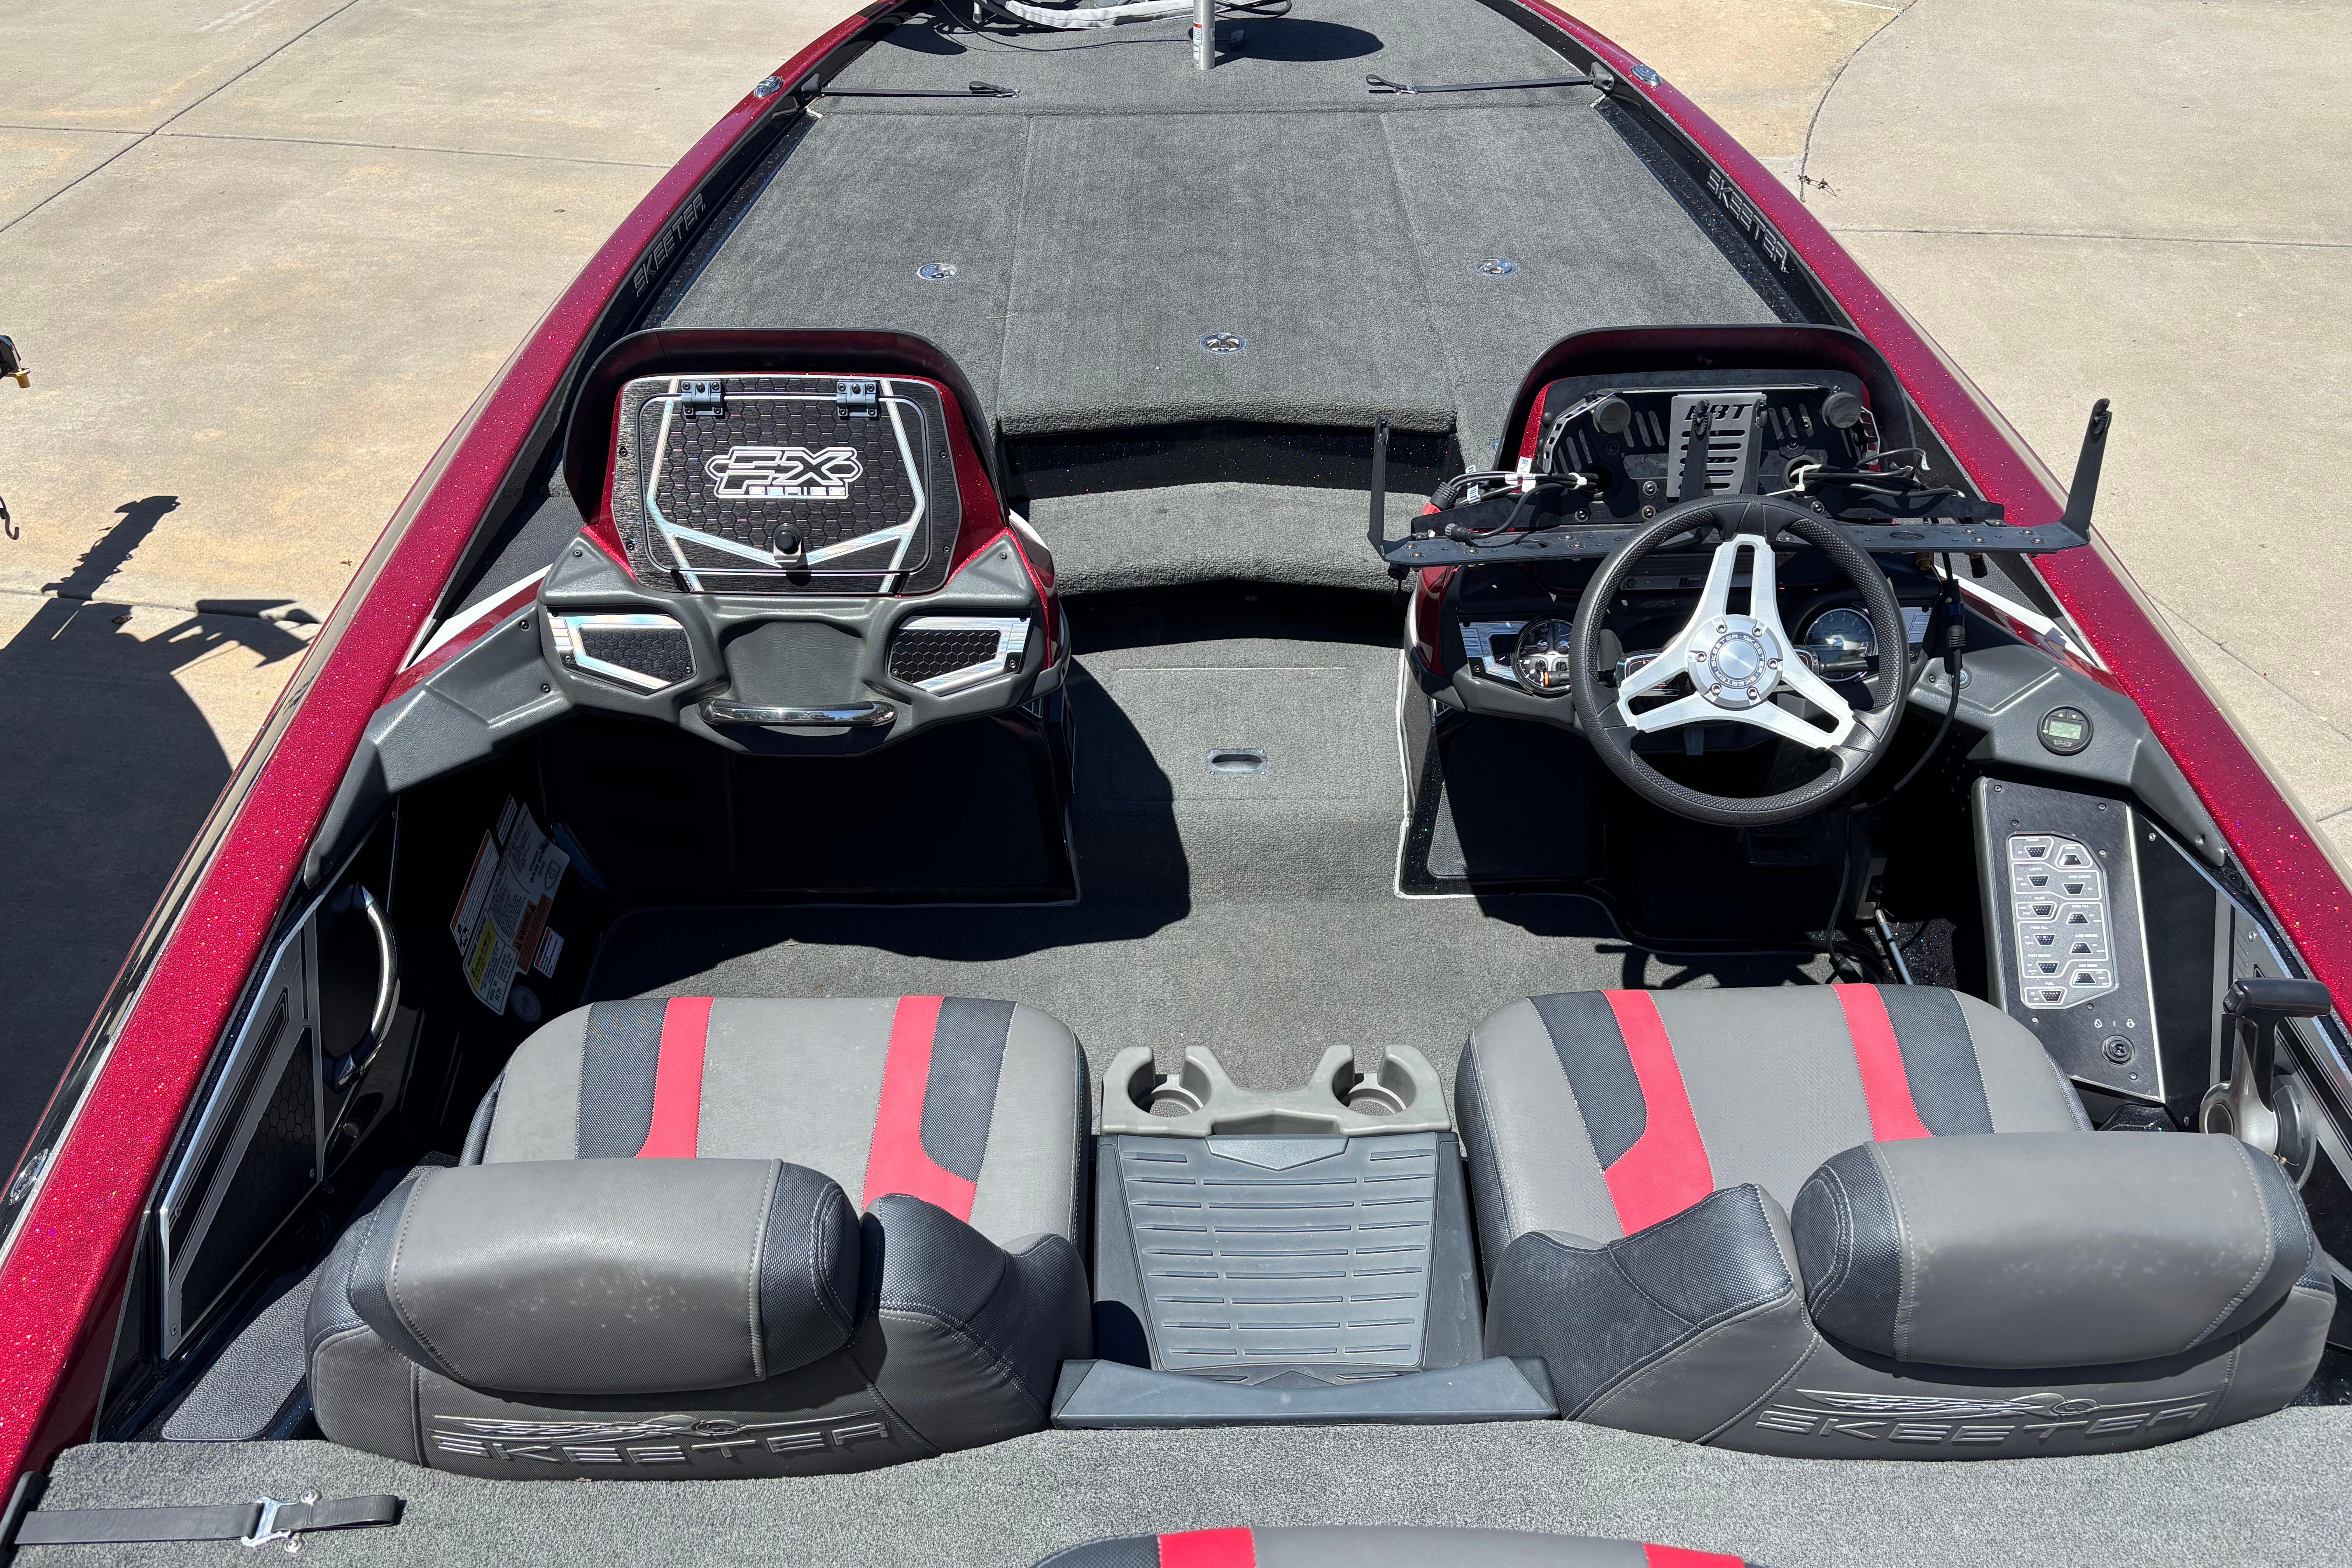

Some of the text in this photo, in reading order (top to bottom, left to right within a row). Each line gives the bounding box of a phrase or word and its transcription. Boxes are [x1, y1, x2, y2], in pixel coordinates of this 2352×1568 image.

[1706, 168, 1787, 271] SKEETER
[634, 193, 704, 297] SKEETER
[710, 449, 859, 495] FX
[749, 486, 846, 496] SERIES
[1711, 634, 1738, 667] SKEETER
[1743, 635, 1764, 673] SKEETER
[1715, 671, 1757, 686] SKEETER
[518, 911, 533, 941] WARNING
[1755, 1403, 2208, 1442] SKEETER
[431, 1421, 892, 1464] SKEETER
